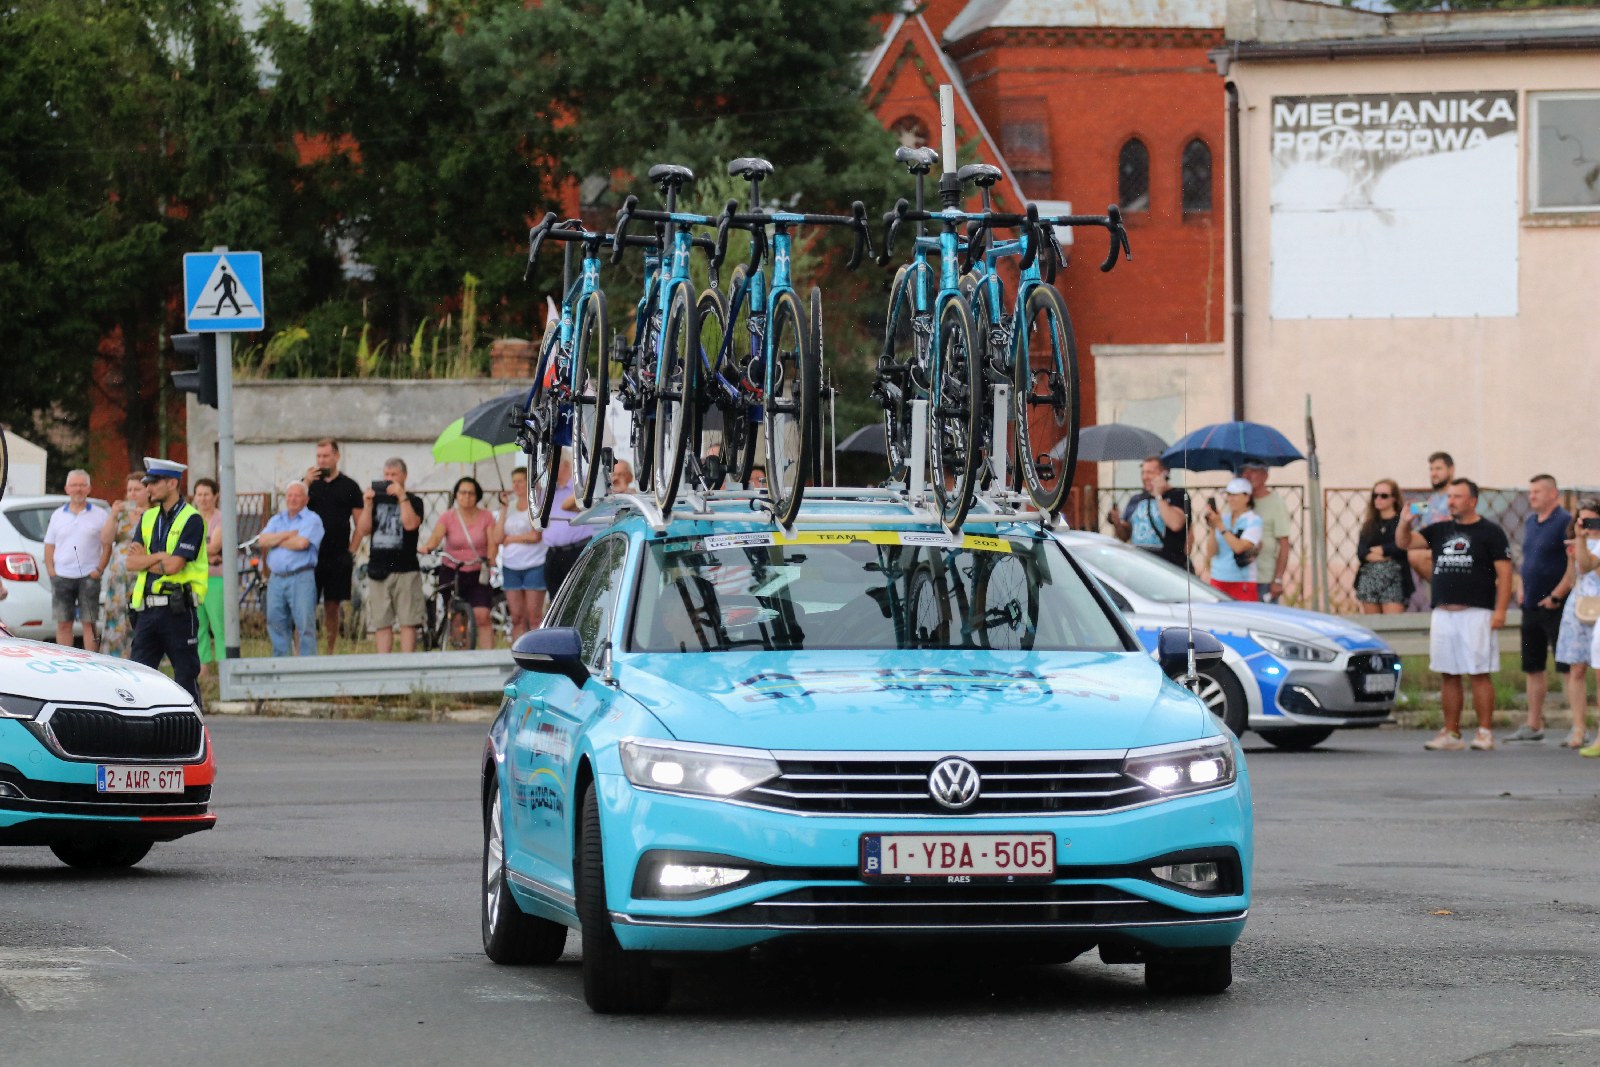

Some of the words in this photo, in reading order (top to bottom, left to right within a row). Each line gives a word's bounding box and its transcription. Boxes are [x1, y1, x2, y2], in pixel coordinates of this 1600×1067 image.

[1273, 98, 1515, 127] MECHANIKA
[1273, 127, 1491, 152] POJAZDOWA
[973, 539, 998, 547] 203
[107, 770, 182, 789] 2-AWR-677
[867, 857, 879, 870] B
[887, 841, 1047, 869] 1-YBA-505
